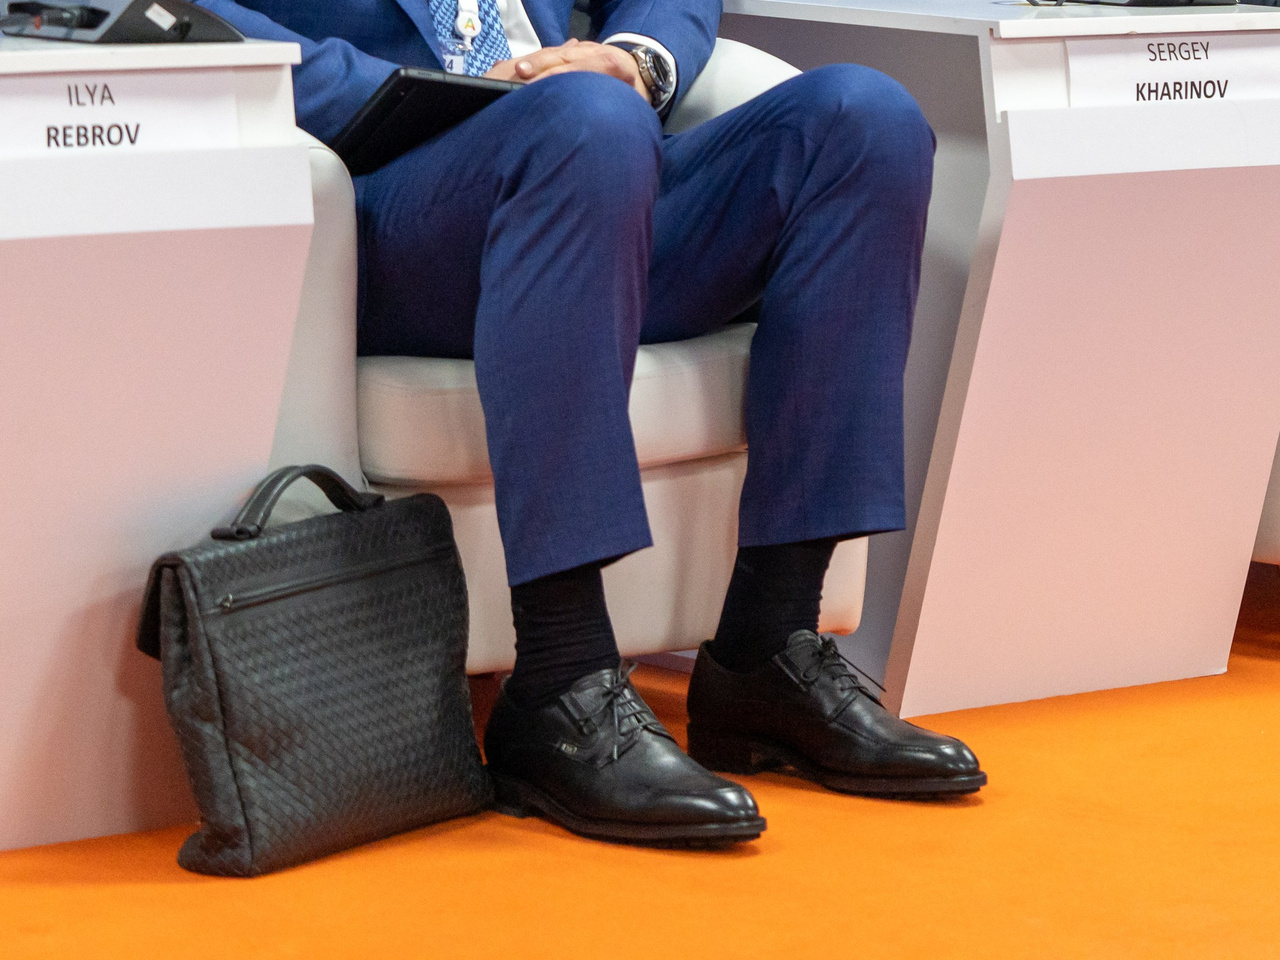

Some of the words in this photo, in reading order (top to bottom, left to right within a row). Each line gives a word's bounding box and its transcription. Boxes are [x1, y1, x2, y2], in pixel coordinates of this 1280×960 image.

[1147, 41, 1210, 62] SERGEY
[67, 82, 116, 107] ILYA
[1135, 79, 1229, 102] KHARINOV
[46, 123, 141, 149] REBROV
